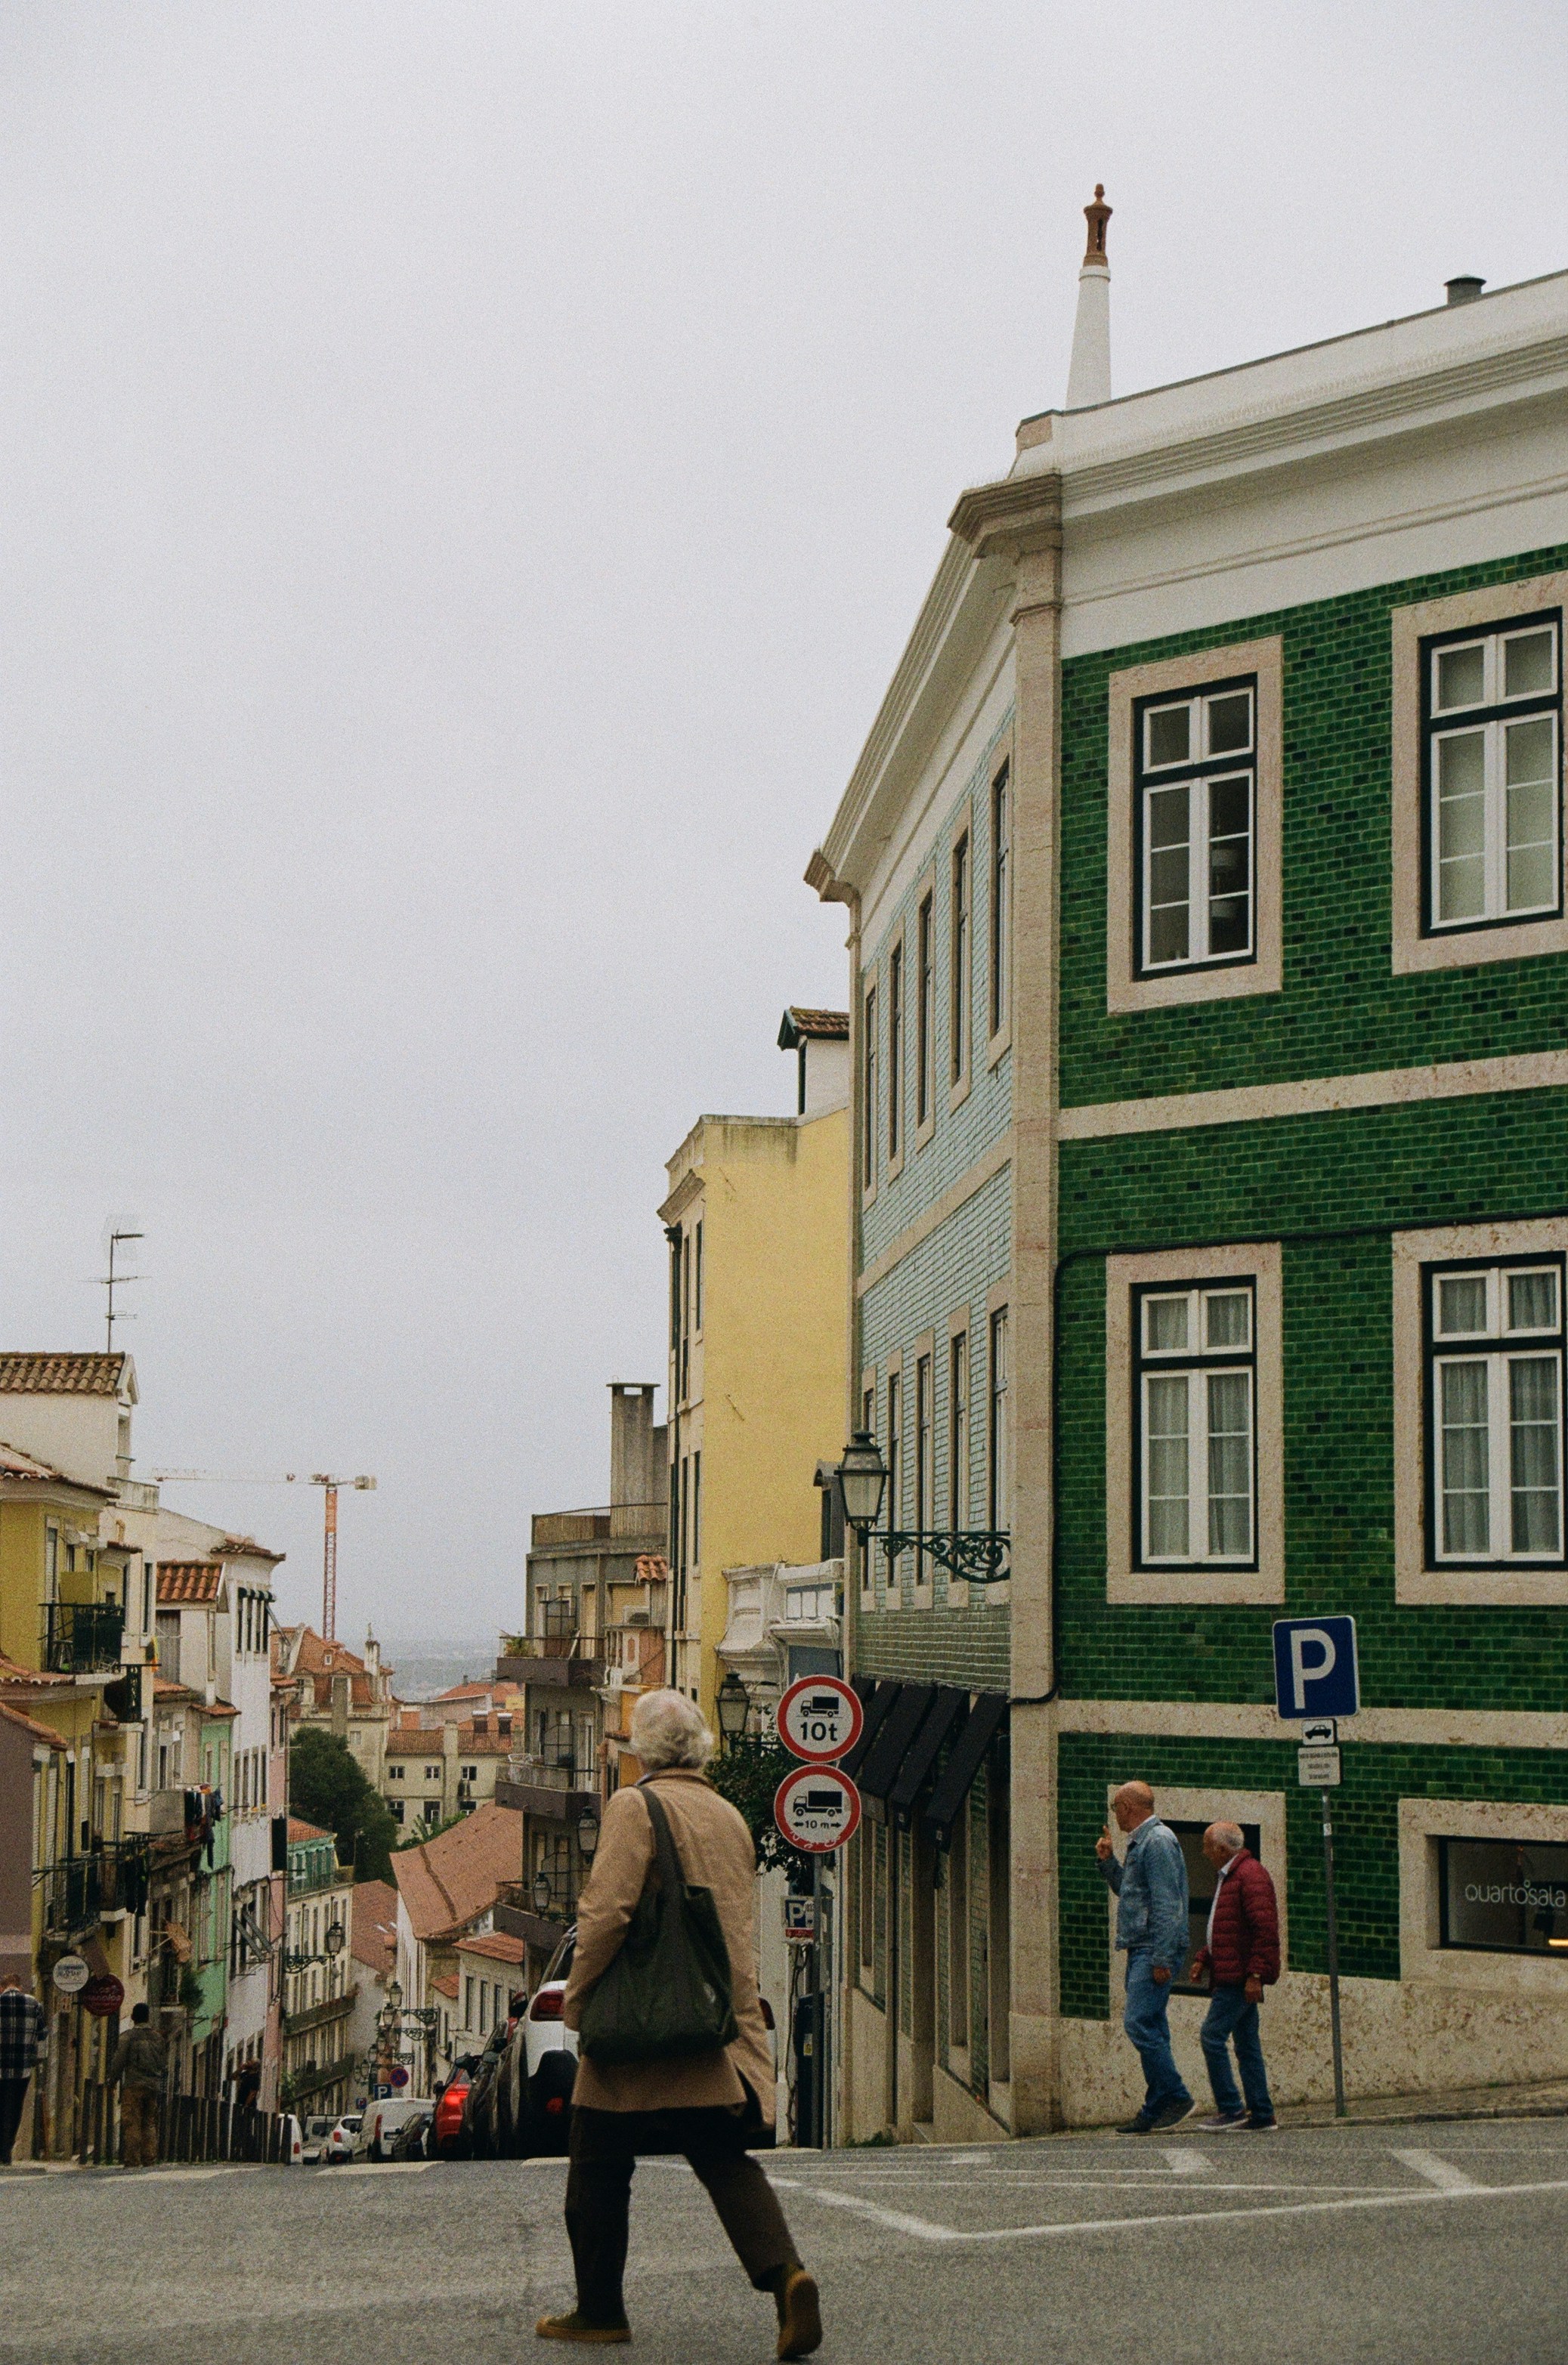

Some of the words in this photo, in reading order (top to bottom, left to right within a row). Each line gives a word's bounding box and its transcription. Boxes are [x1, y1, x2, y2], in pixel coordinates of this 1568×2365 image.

[1290, 1628, 1336, 1709] P
[805, 1820, 817, 1829] 10
[789, 1903, 806, 1926] P
[378, 2086, 388, 2099] P
